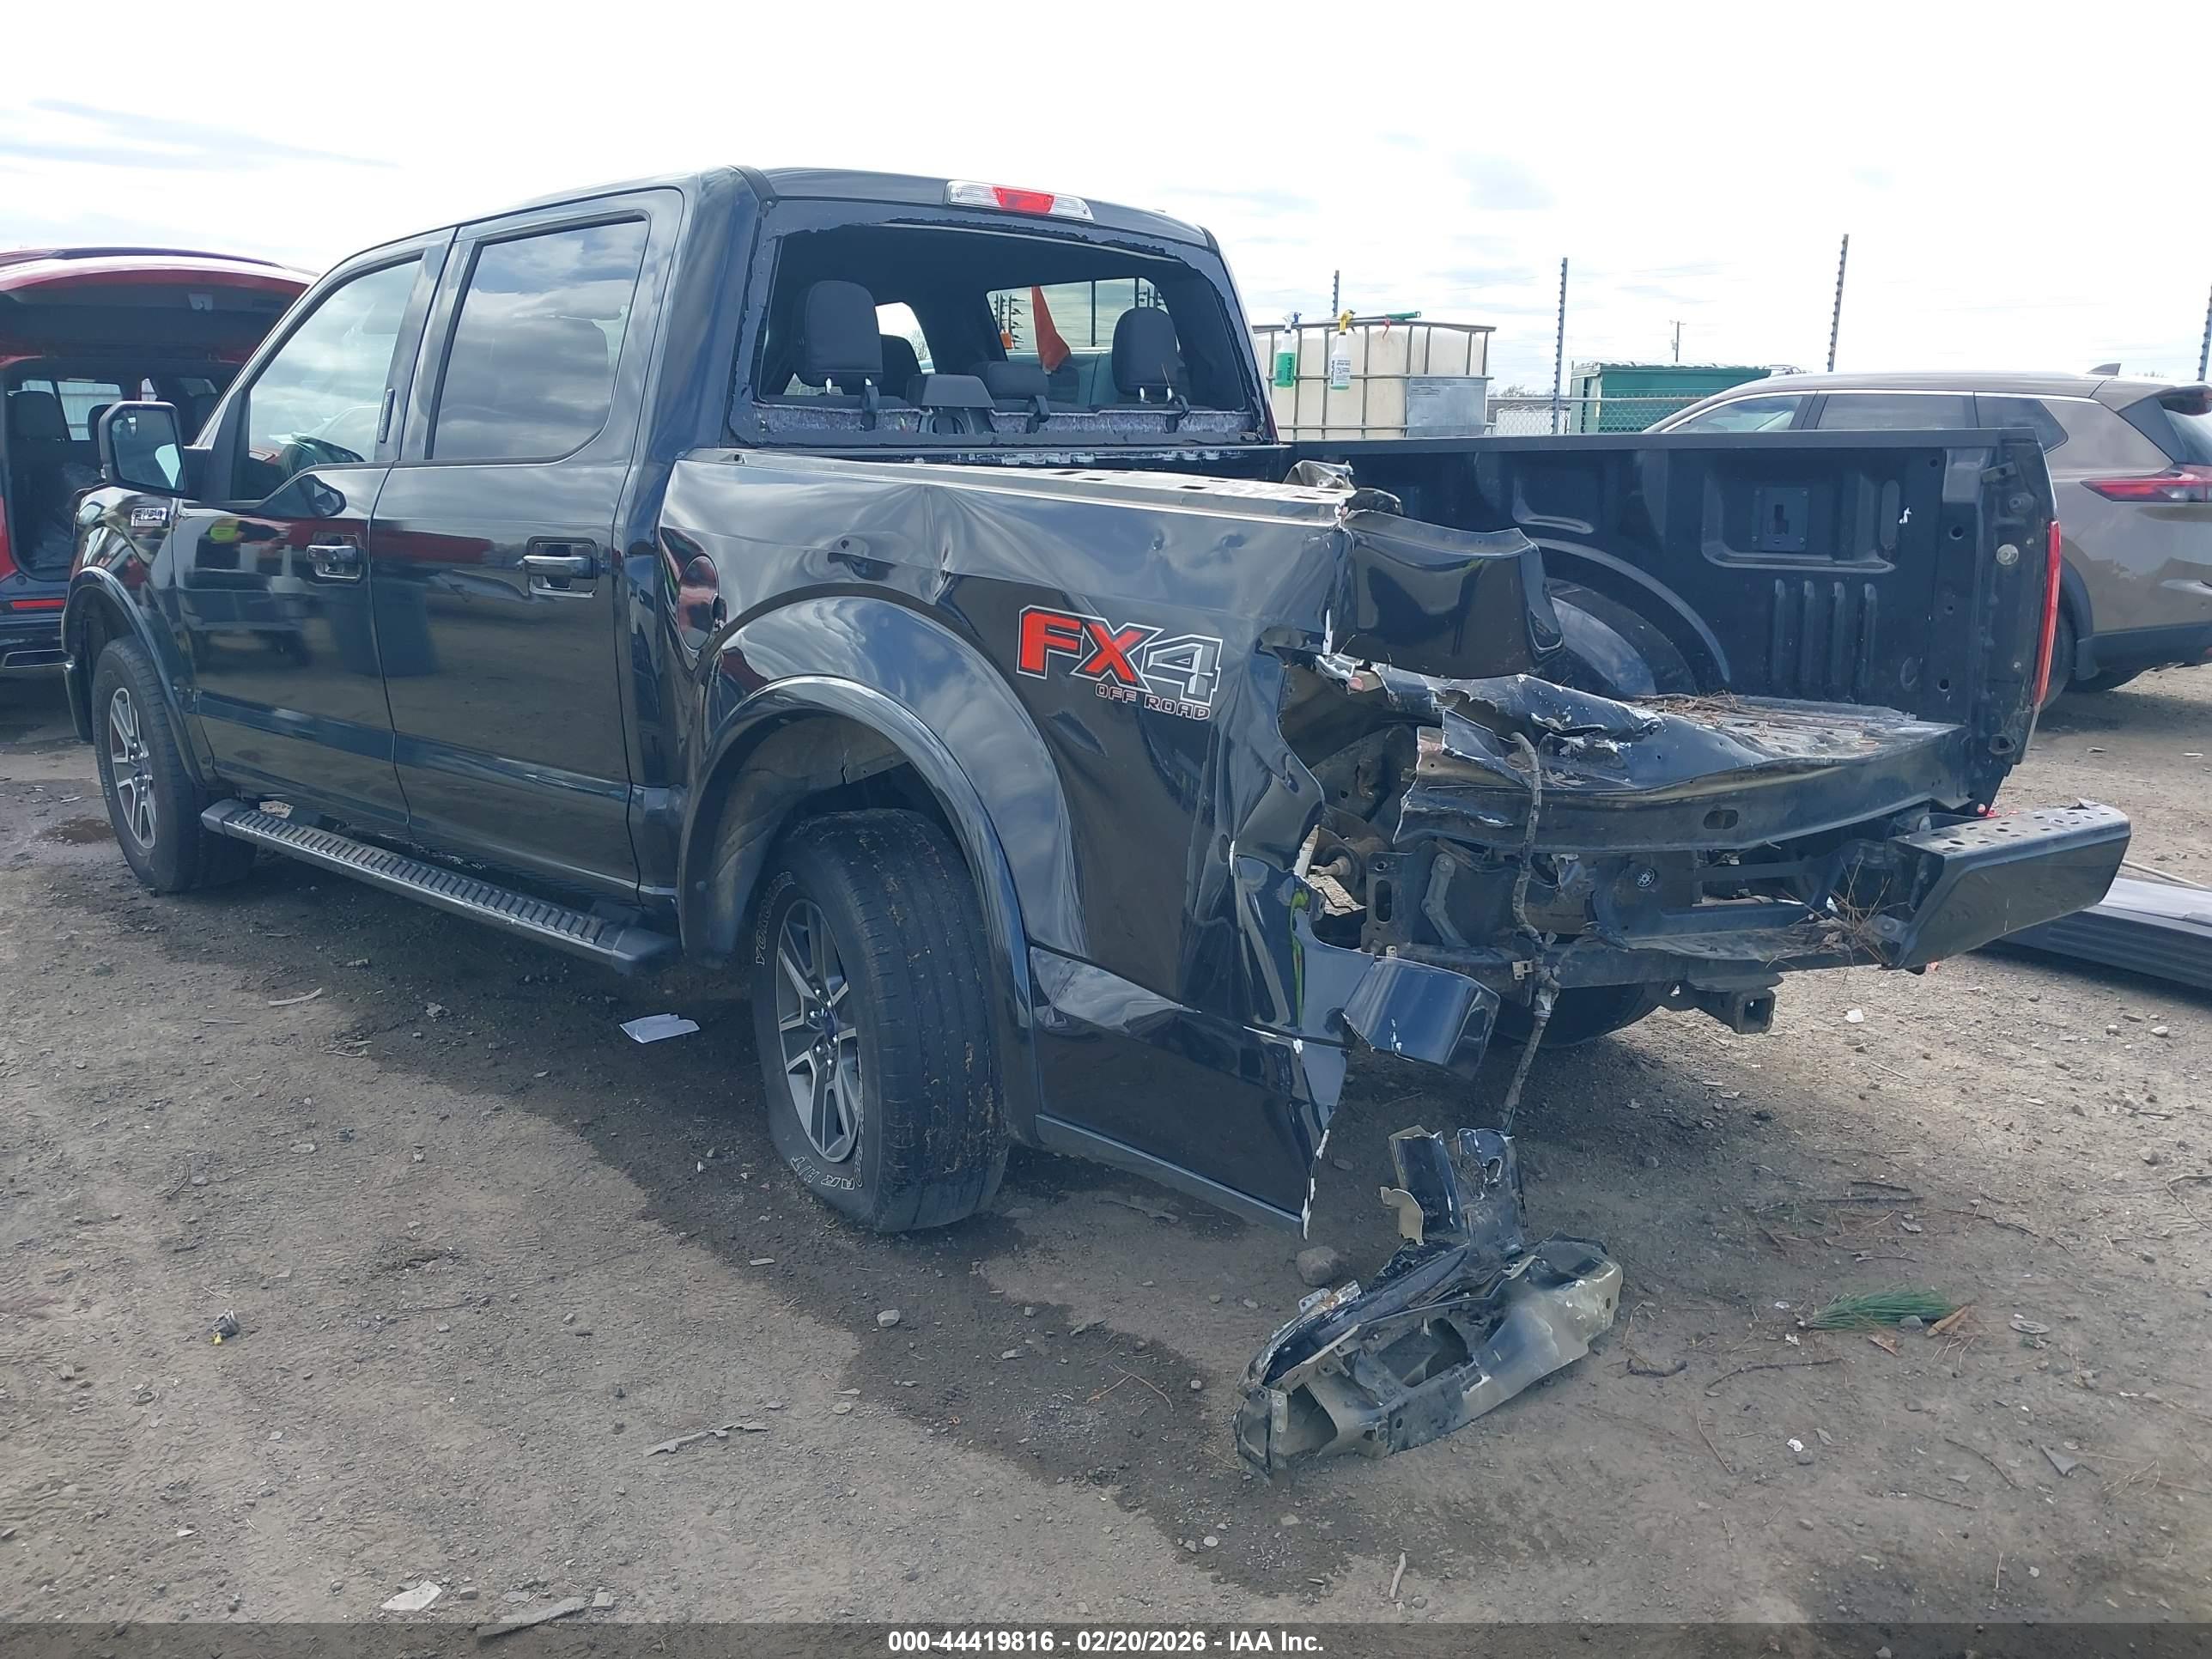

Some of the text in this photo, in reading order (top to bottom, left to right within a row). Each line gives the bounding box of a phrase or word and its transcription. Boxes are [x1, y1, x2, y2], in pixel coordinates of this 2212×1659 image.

[1017, 605, 1223, 707] FX4
[1096, 683, 1211, 720] OFF ROAD
[755, 870, 797, 967] YOKO
